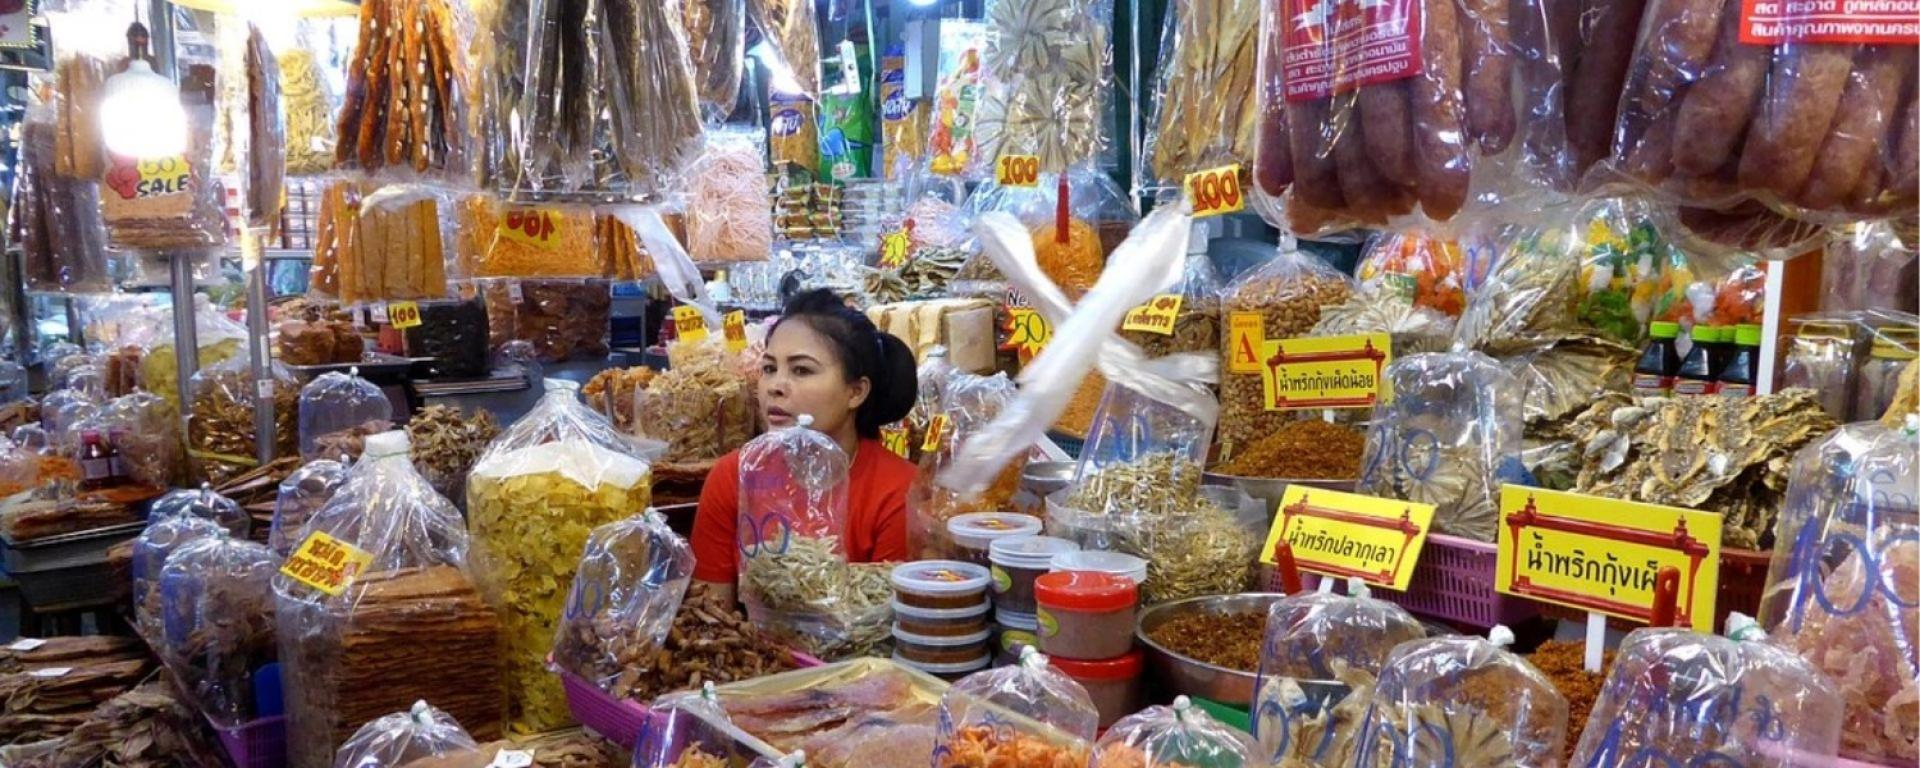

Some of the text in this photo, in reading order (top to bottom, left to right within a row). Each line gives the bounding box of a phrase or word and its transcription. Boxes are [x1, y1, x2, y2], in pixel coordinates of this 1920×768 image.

[137, 174, 189, 197] SALE
[1001, 156, 1038, 185] 100
[1189, 170, 1239, 211] 100
[393, 306, 416, 325] 100
[1015, 312, 1045, 343] 50
[1235, 330, 1258, 363] A
[1280, 368, 1374, 397] น้ำพริกกุ้งเผ็ดน้อย
[1288, 518, 1395, 568] น้ำพริกปลากุเลา
[1528, 531, 1659, 596] น้ำพริกกุ้งเผ็
